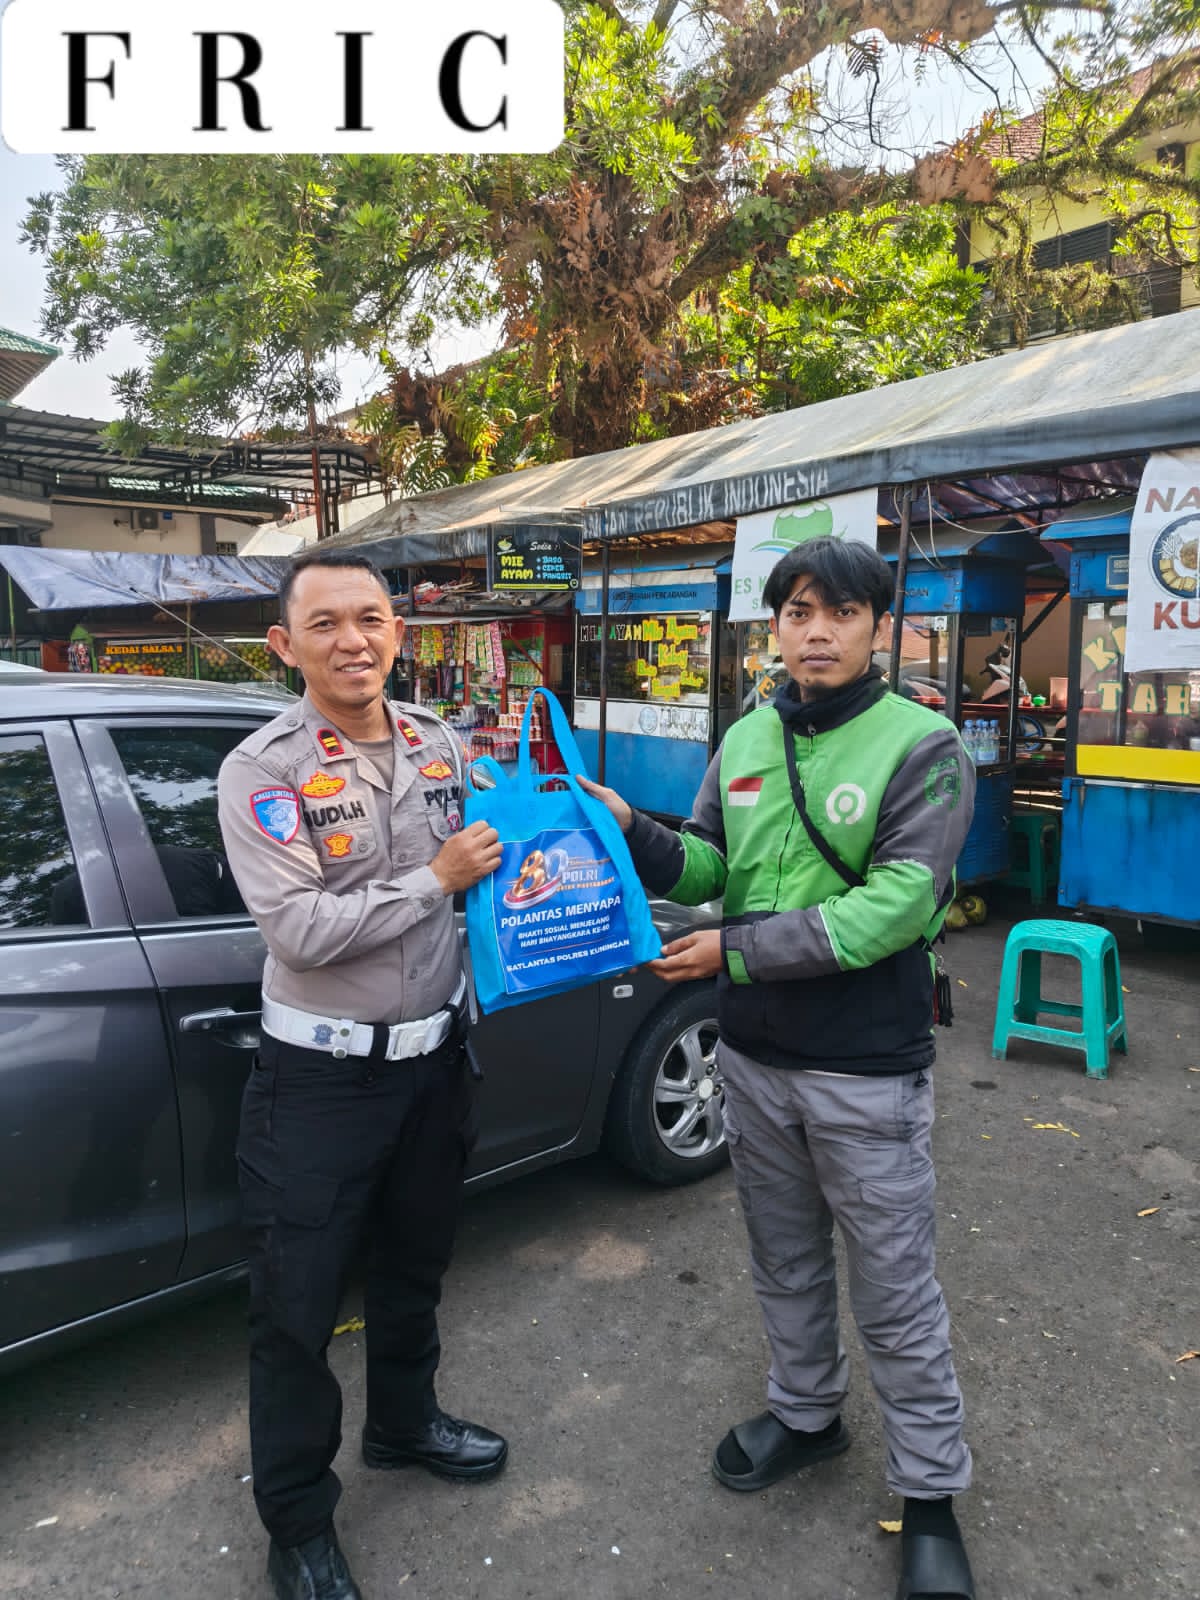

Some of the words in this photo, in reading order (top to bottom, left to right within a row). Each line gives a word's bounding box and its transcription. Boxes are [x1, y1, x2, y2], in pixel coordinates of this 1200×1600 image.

[634, 483, 714, 531] REPUBLIK
[724, 468, 829, 513] INDONESIA
[1144, 487, 1200, 513] NA
[501, 555, 524, 566] MIE
[542, 556, 563, 564] BASO
[501, 568, 534, 580] AYAM
[735, 576, 752, 594] ES
[1153, 600, 1200, 631] KU
[609, 623, 642, 641] AYAM
[1098, 681, 1192, 717] TAH
[562, 869, 598, 885] POLRI
[501, 907, 562, 928] POLANTAS
[565, 896, 621, 916] MENYAPA
[518, 928, 543, 940] BHAKTI
[544, 924, 569, 935] SOSIAL
[570, 915, 610, 930] MENJELANG
[520, 939, 538, 948] HARI
[539, 930, 591, 945] BHAYANGKARA
[506, 956, 555, 972] SATLANTAS
[556, 950, 589, 963] POLRES
[590, 939, 630, 956] KUNINGAN
